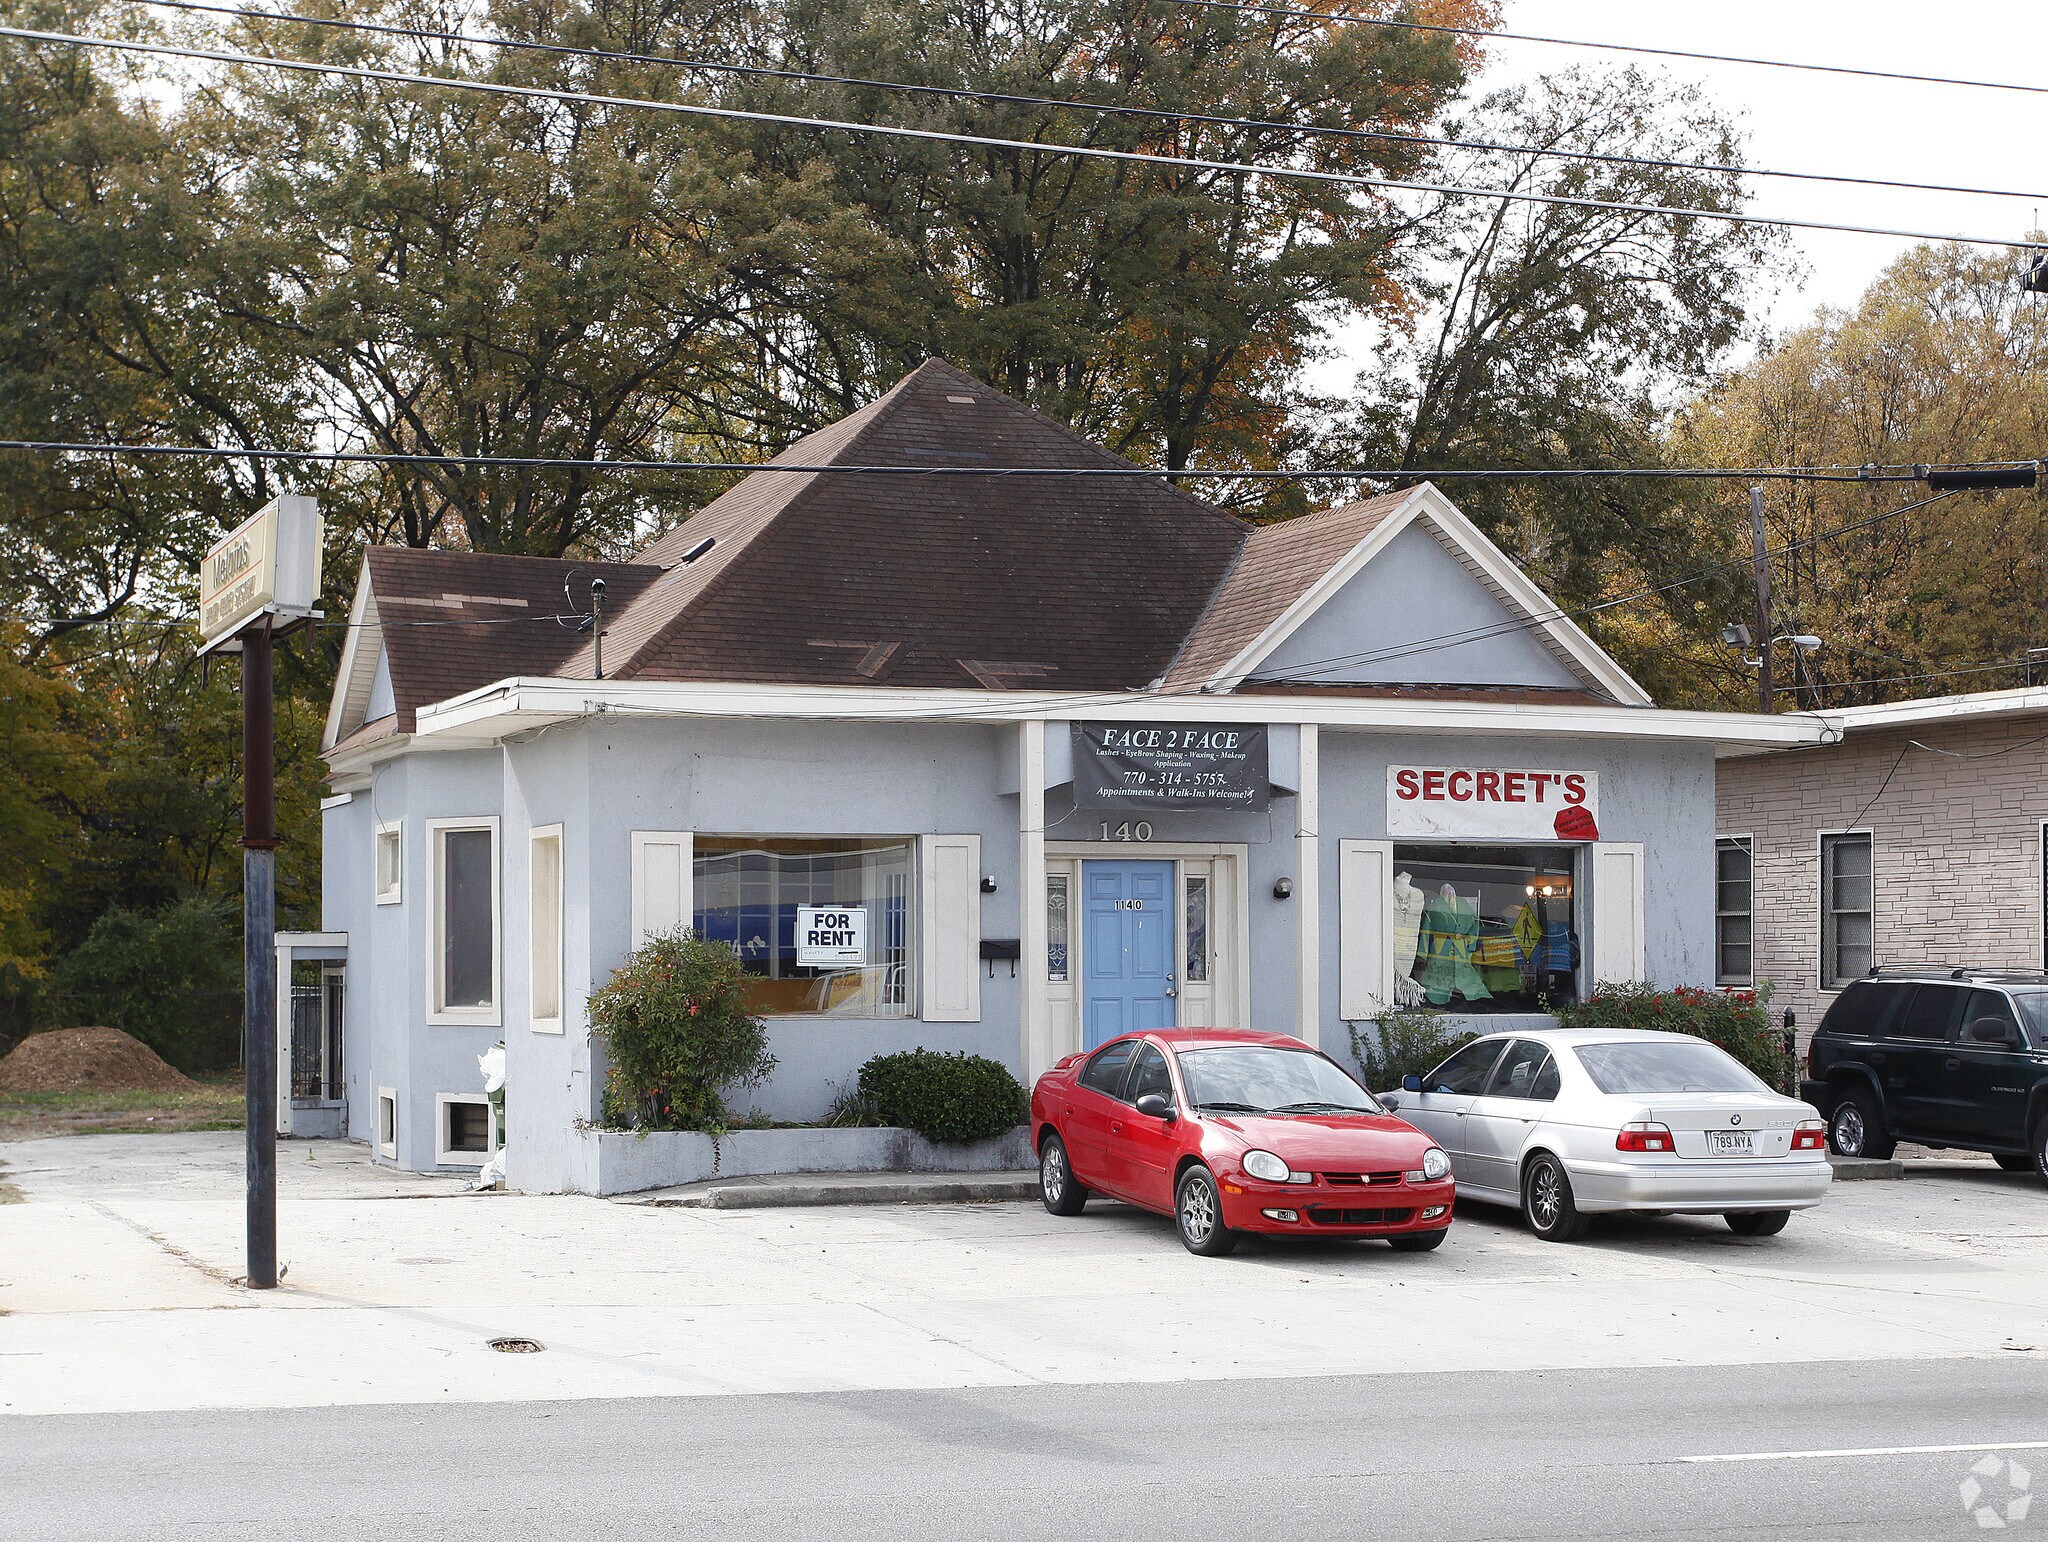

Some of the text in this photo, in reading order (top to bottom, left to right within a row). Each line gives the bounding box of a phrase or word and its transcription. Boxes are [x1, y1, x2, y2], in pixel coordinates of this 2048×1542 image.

[1102, 729, 1239, 749] FACE 2 FACE
[1096, 748, 1119, 756] Lashes
[1126, 750, 1155, 758] EyeBrow
[1156, 750, 1183, 760] Shaping
[1189, 751, 1214, 761] Waxing
[1221, 752, 1246, 760] Makeup
[1154, 760, 1192, 768] Application
[1123, 771, 1147, 785] 770
[1159, 772, 1182, 785] 314
[1097, 786, 1155, 798] Appointments
[1157, 788, 1165, 797] &
[1168, 788, 1206, 798] Walk-Ins
[1396, 769, 1586, 805] SECRET'S
[1100, 821, 1153, 842] 140
[1115, 900, 1142, 910] 1140
[814, 914, 850, 928] FOR
[807, 930, 856, 946] RENT
[1714, 1136, 1753, 1148] 789 NYA
